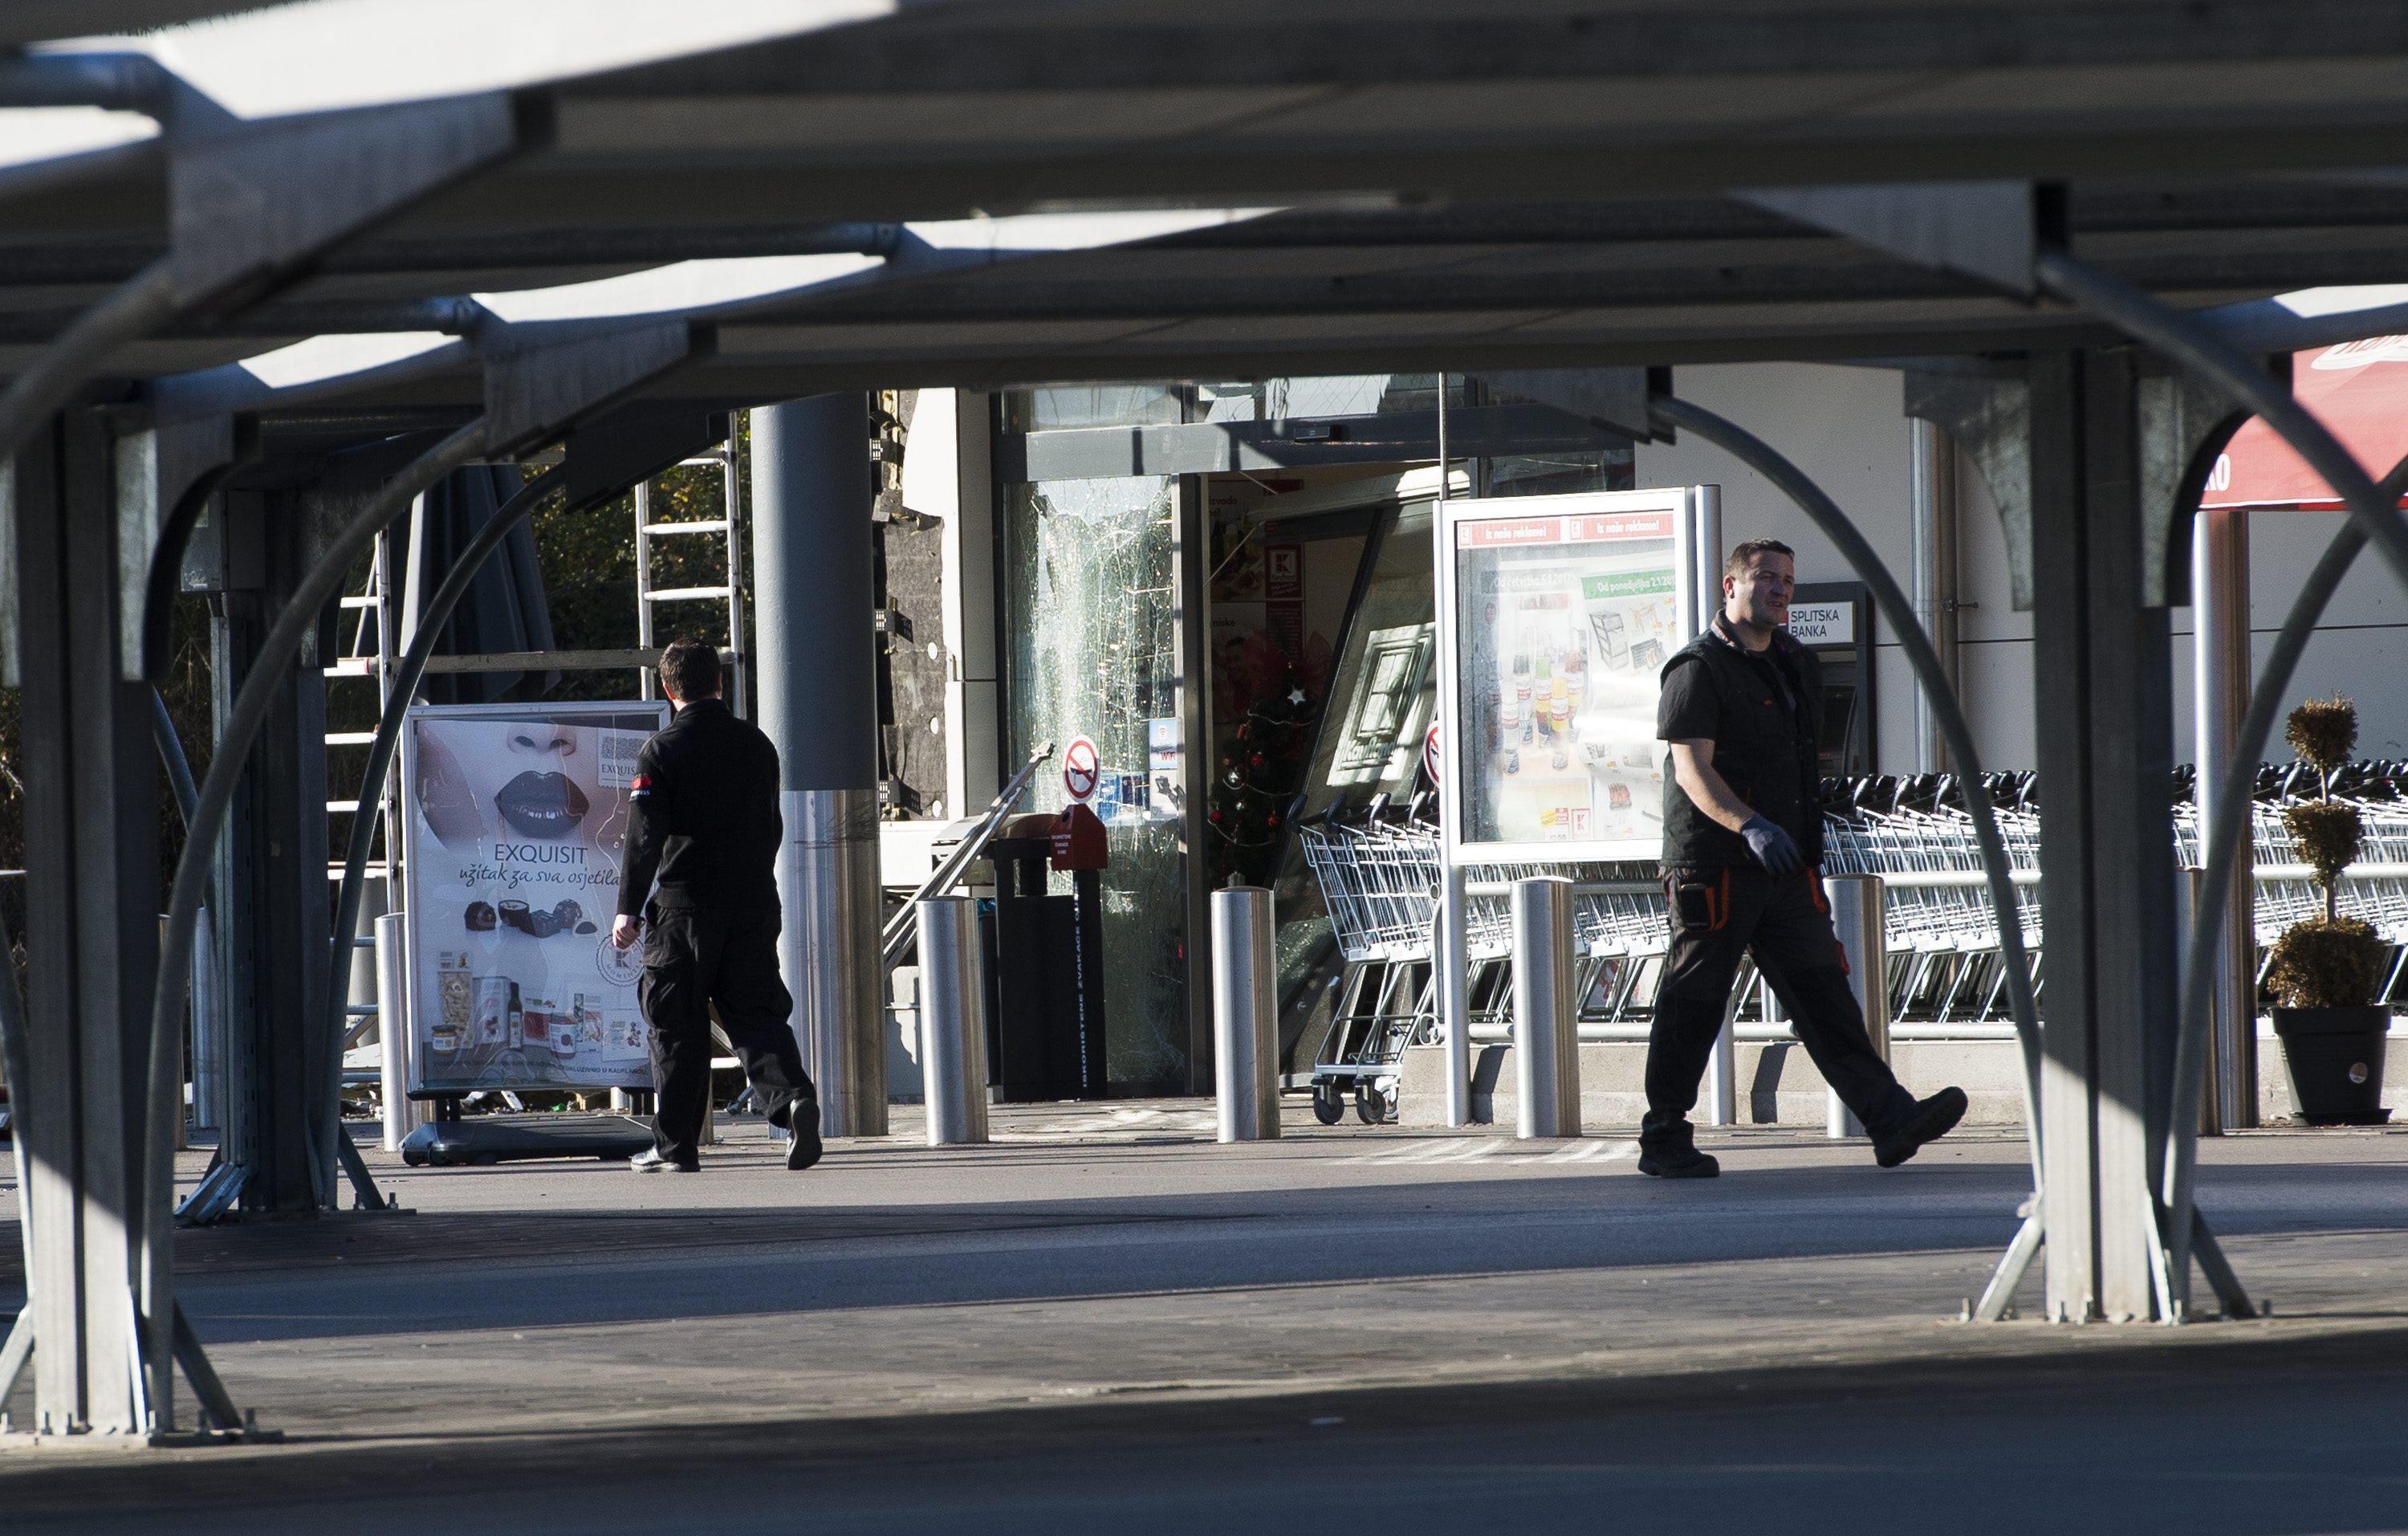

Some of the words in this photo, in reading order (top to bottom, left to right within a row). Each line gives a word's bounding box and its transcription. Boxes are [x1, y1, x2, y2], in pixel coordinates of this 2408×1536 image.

[1597, 581, 1609, 593] Od
[1791, 609, 1840, 623] SPLITSKA
[1791, 625, 1827, 638] BANKA
[494, 843, 588, 864] EXQUISIT
[459, 862, 508, 887] užitak
[508, 870, 533, 890] za
[537, 870, 564, 884] sva
[567, 866, 620, 891] osjetila
